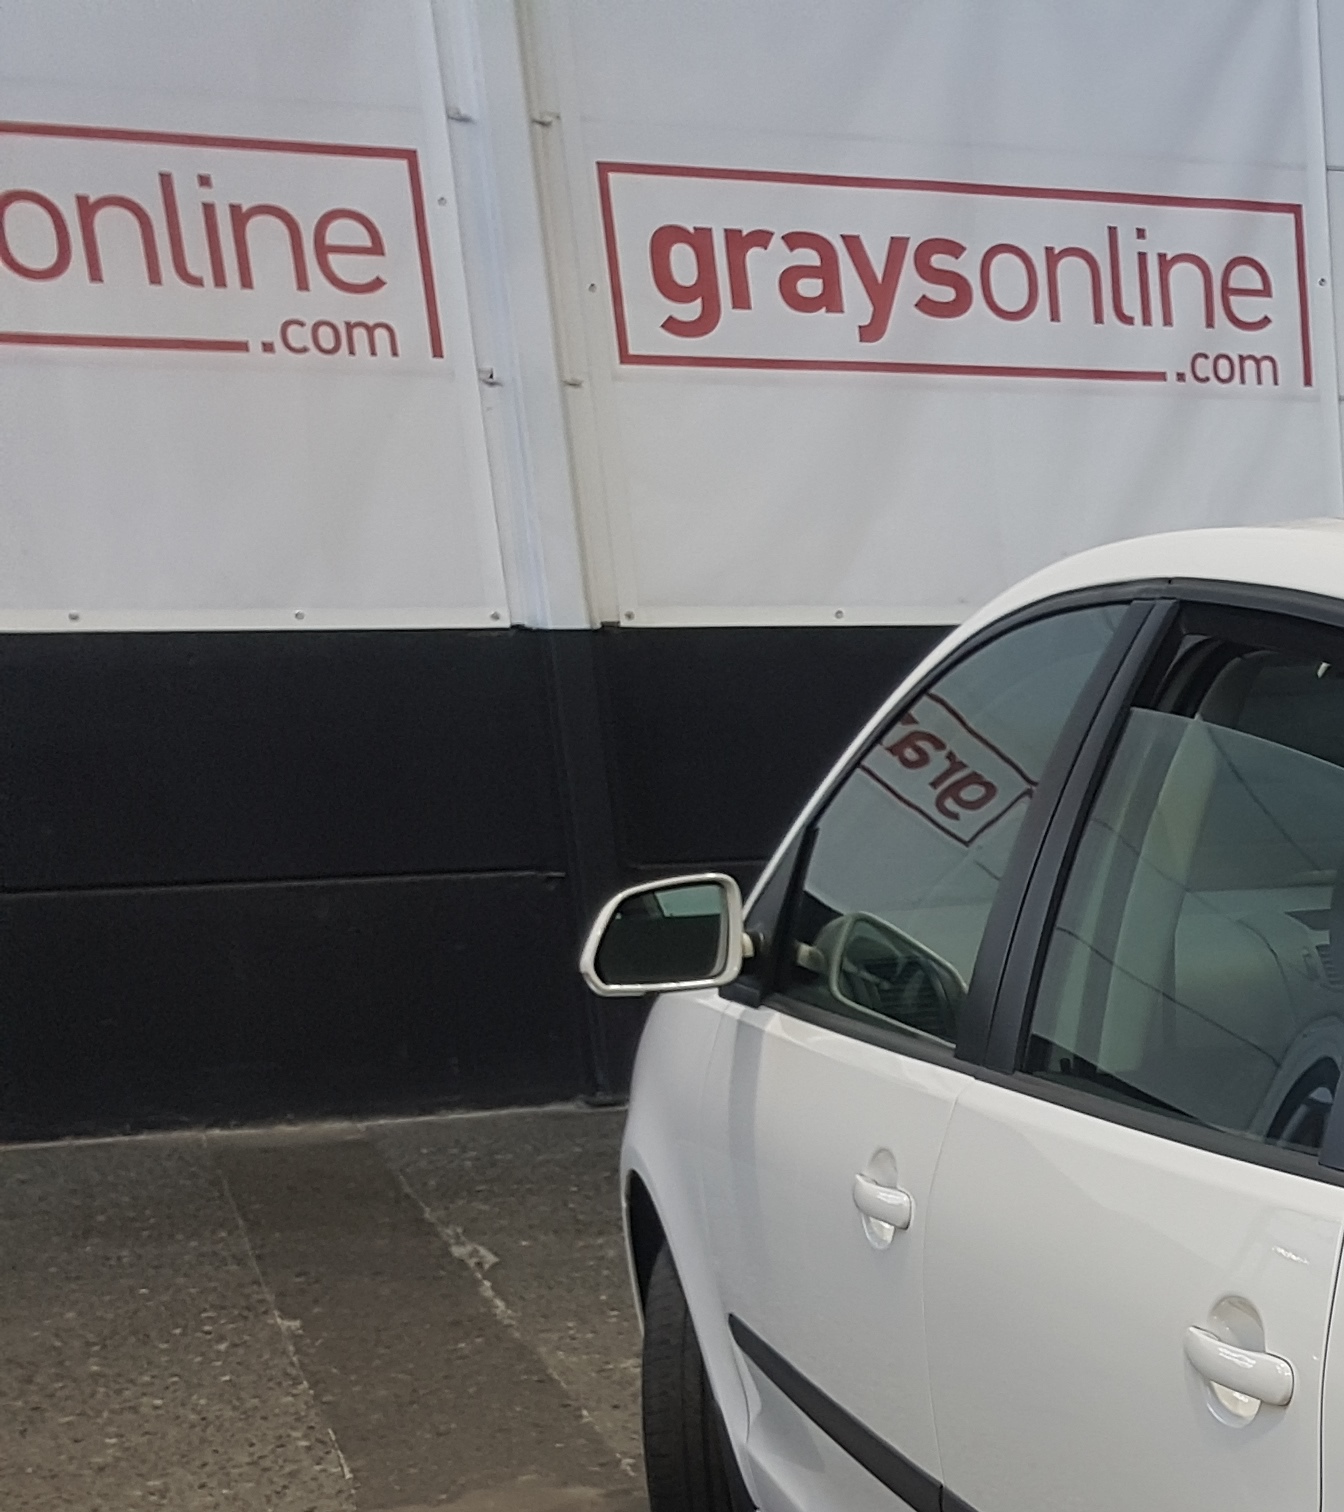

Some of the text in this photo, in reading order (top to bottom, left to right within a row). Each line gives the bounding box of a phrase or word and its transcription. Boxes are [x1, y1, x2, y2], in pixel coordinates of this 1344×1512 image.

[648, 223, 1274, 343] graysonline
[261, 318, 401, 358] .com
[1174, 350, 1280, 387] .com
